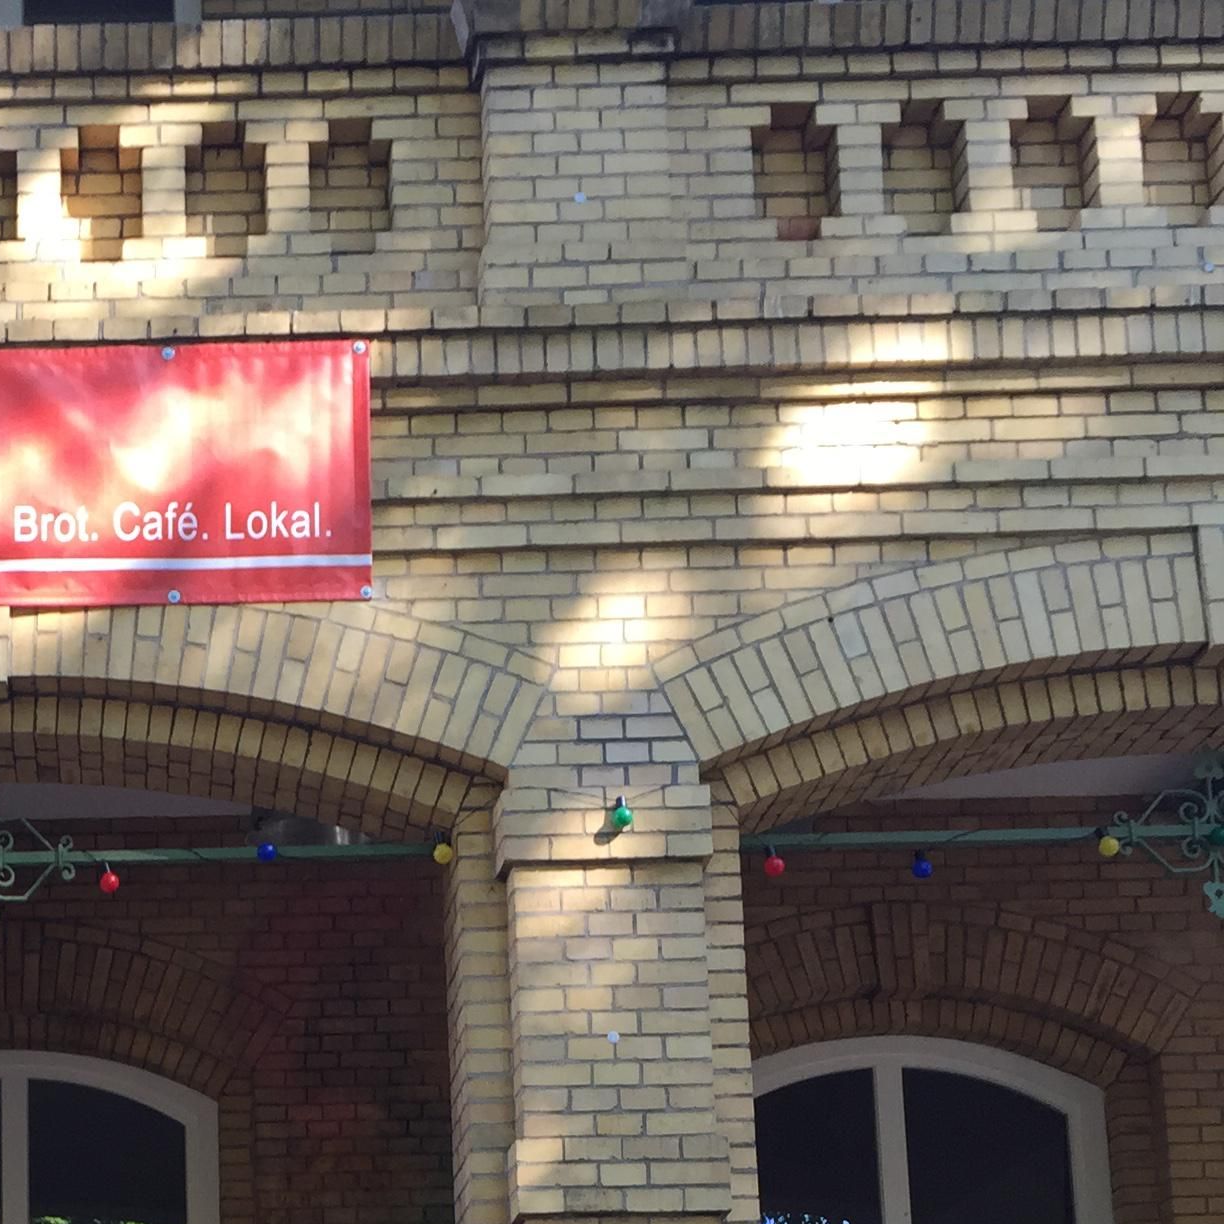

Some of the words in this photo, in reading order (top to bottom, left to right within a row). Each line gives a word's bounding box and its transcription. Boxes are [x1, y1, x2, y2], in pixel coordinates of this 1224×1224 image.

[13, 504, 98, 542] Brot.
[112, 501, 209, 541] Café.
[224, 501, 332, 540] Lokal.
